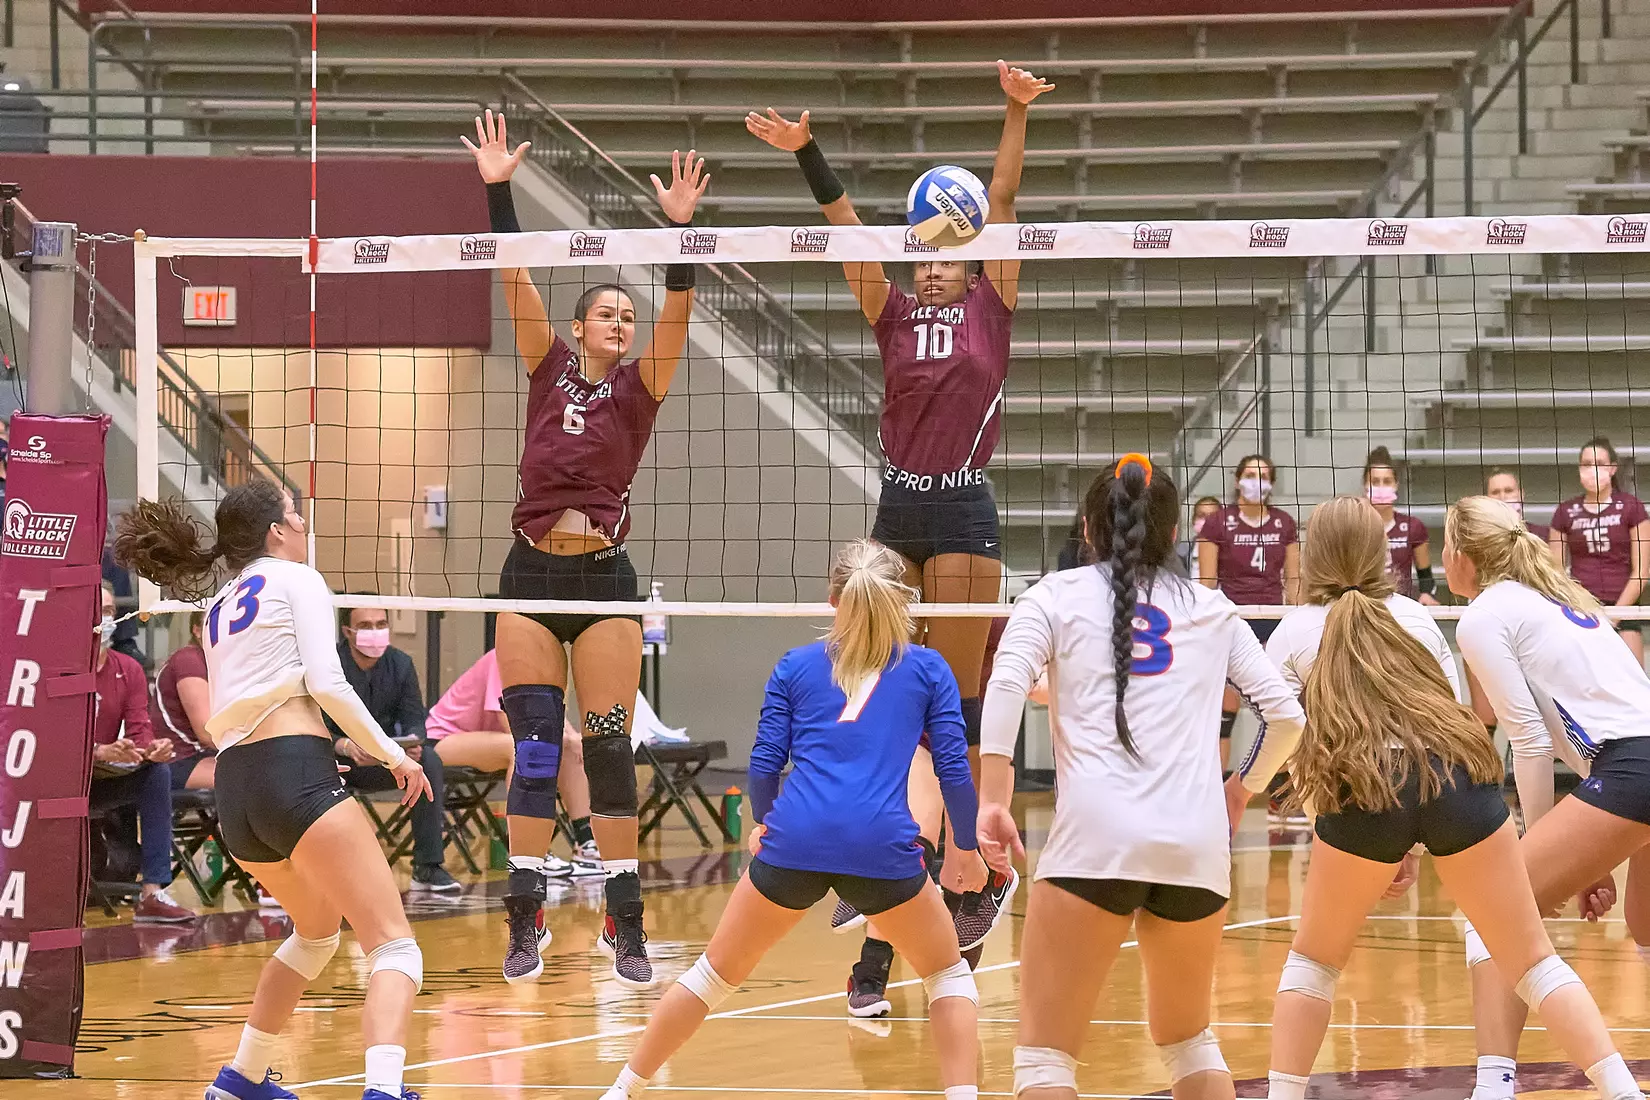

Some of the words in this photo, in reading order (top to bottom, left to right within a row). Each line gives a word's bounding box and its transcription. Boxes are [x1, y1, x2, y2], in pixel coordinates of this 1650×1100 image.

[935, 192, 969, 231] molten
[194, 292, 228, 320] EXIT
[913, 322, 953, 360] 10
[562, 403, 587, 435] 6
[895, 469, 933, 492] PRO
[940, 468, 982, 490] NIKE
[24, 529, 68, 541] ROCK
[28, 516, 73, 530] LITTLE
[3, 542, 61, 555] VOLLEYBALL
[1582, 528, 1610, 553] 15
[594, 547, 616, 562] NIKE
[1250, 546, 1266, 572] 4
[208, 574, 267, 648] 13
[0, 588, 48, 1061] TROJANS
